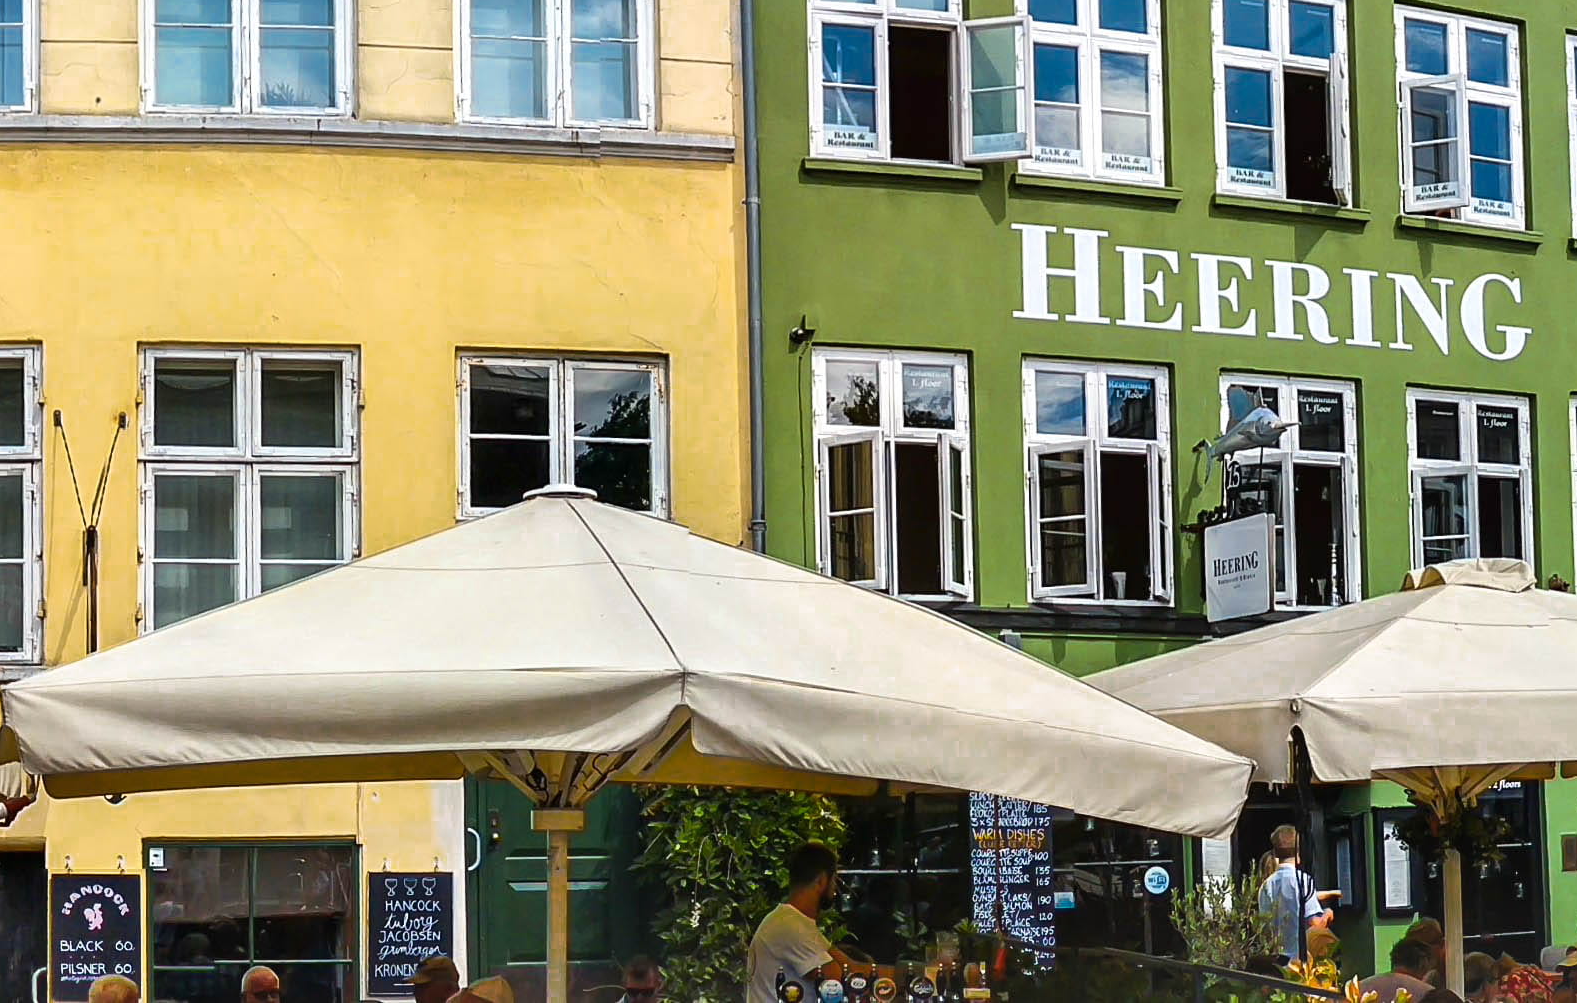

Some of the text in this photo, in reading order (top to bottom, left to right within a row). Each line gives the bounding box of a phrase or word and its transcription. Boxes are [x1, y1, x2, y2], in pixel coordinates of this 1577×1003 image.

[834, 132, 855, 140] BAR
[1040, 148, 1061, 157] BAR
[1111, 155, 1131, 164] BAR
[1236, 169, 1255, 177] BAR
[1421, 185, 1440, 193] BAR
[1478, 200, 1496, 208] BAR
[1011, 223, 1532, 361] HEERING
[1213, 551, 1259, 577] HEERING
[1007, 829, 1045, 840] DISHES
[61, 884, 129, 916] HANCOCK
[384, 900, 441, 912] HANCOCK
[384, 912, 439, 933] tuborg
[378, 930, 441, 943] JACOBSEN
[60, 940, 104, 952] BLACK
[60, 963, 107, 975] PILSNER
[374, 963, 418, 977] KRONEN
